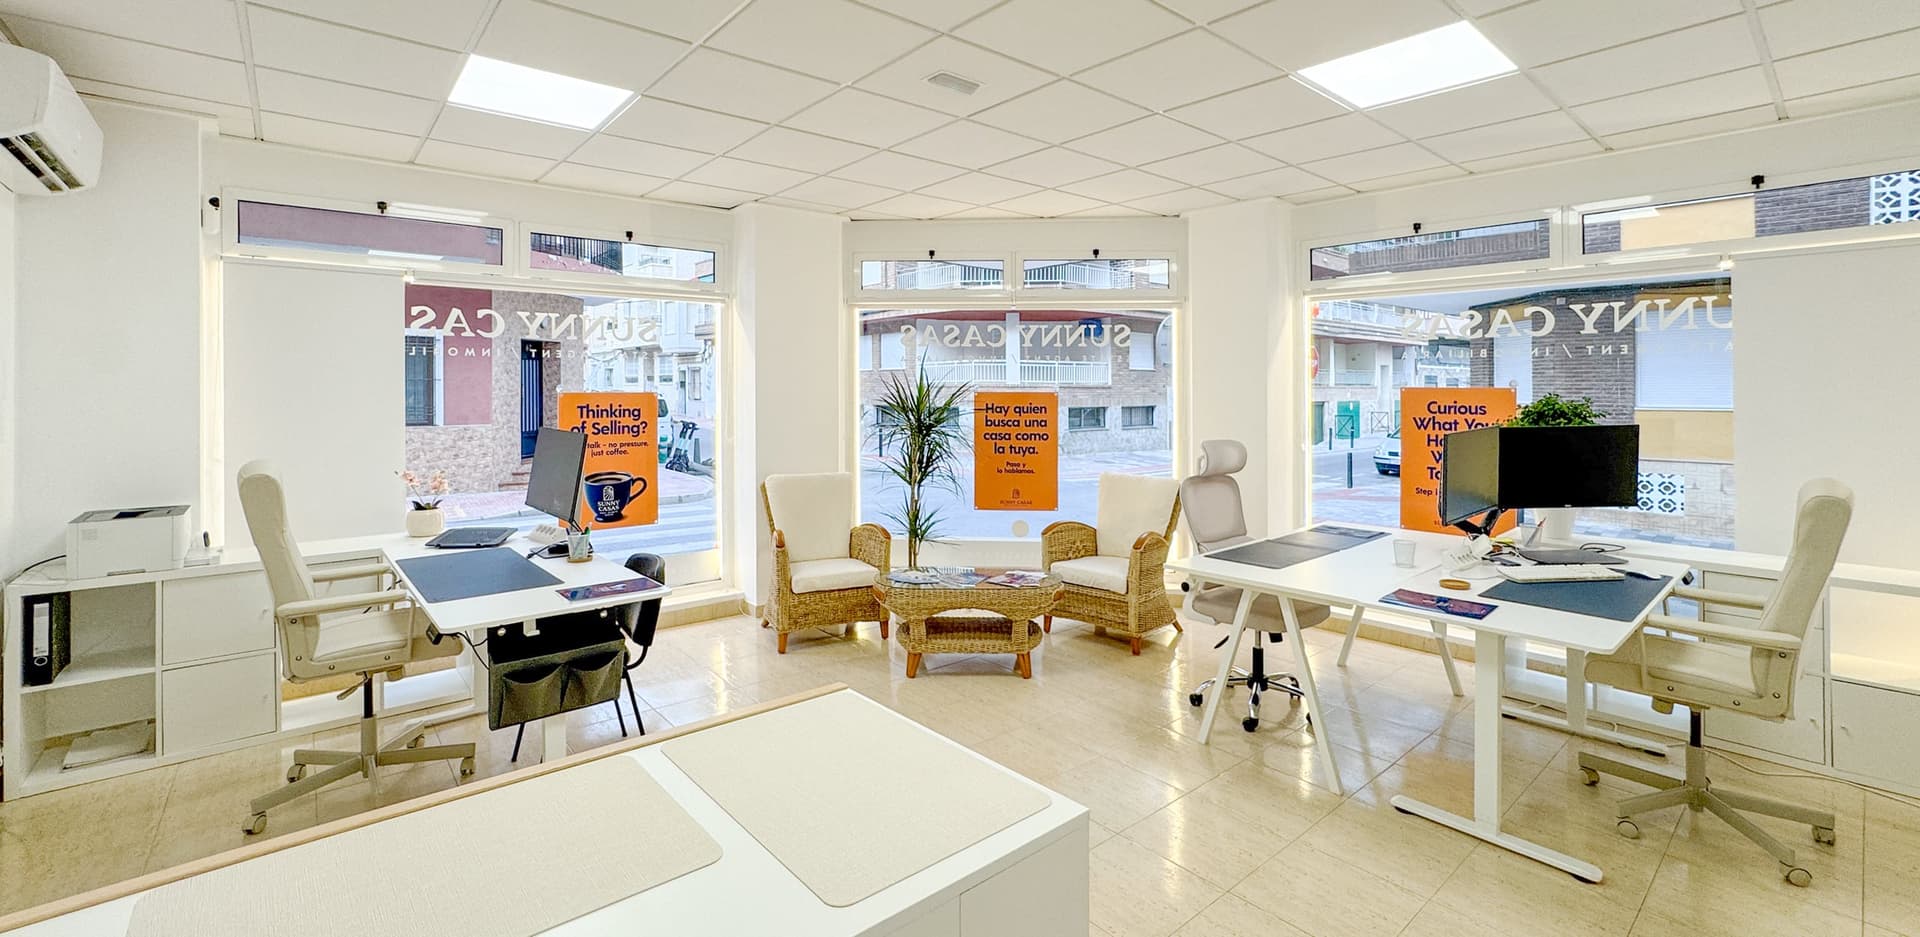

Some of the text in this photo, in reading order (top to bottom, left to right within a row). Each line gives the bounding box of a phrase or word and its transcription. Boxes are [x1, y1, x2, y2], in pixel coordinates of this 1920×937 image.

[577, 404, 641, 421] Thinking
[985, 403, 1047, 417] Hay quien
[1427, 400, 1487, 416] Curious
[985, 415, 1047, 428] busca una
[1413, 416, 1459, 432] What
[570, 420, 648, 438] of Selling?
[983, 431, 1049, 441] casa como
[591, 448, 630, 458] just coffee.
[994, 442, 1039, 457] la tuya.
[1416, 487, 1433, 497] Step
